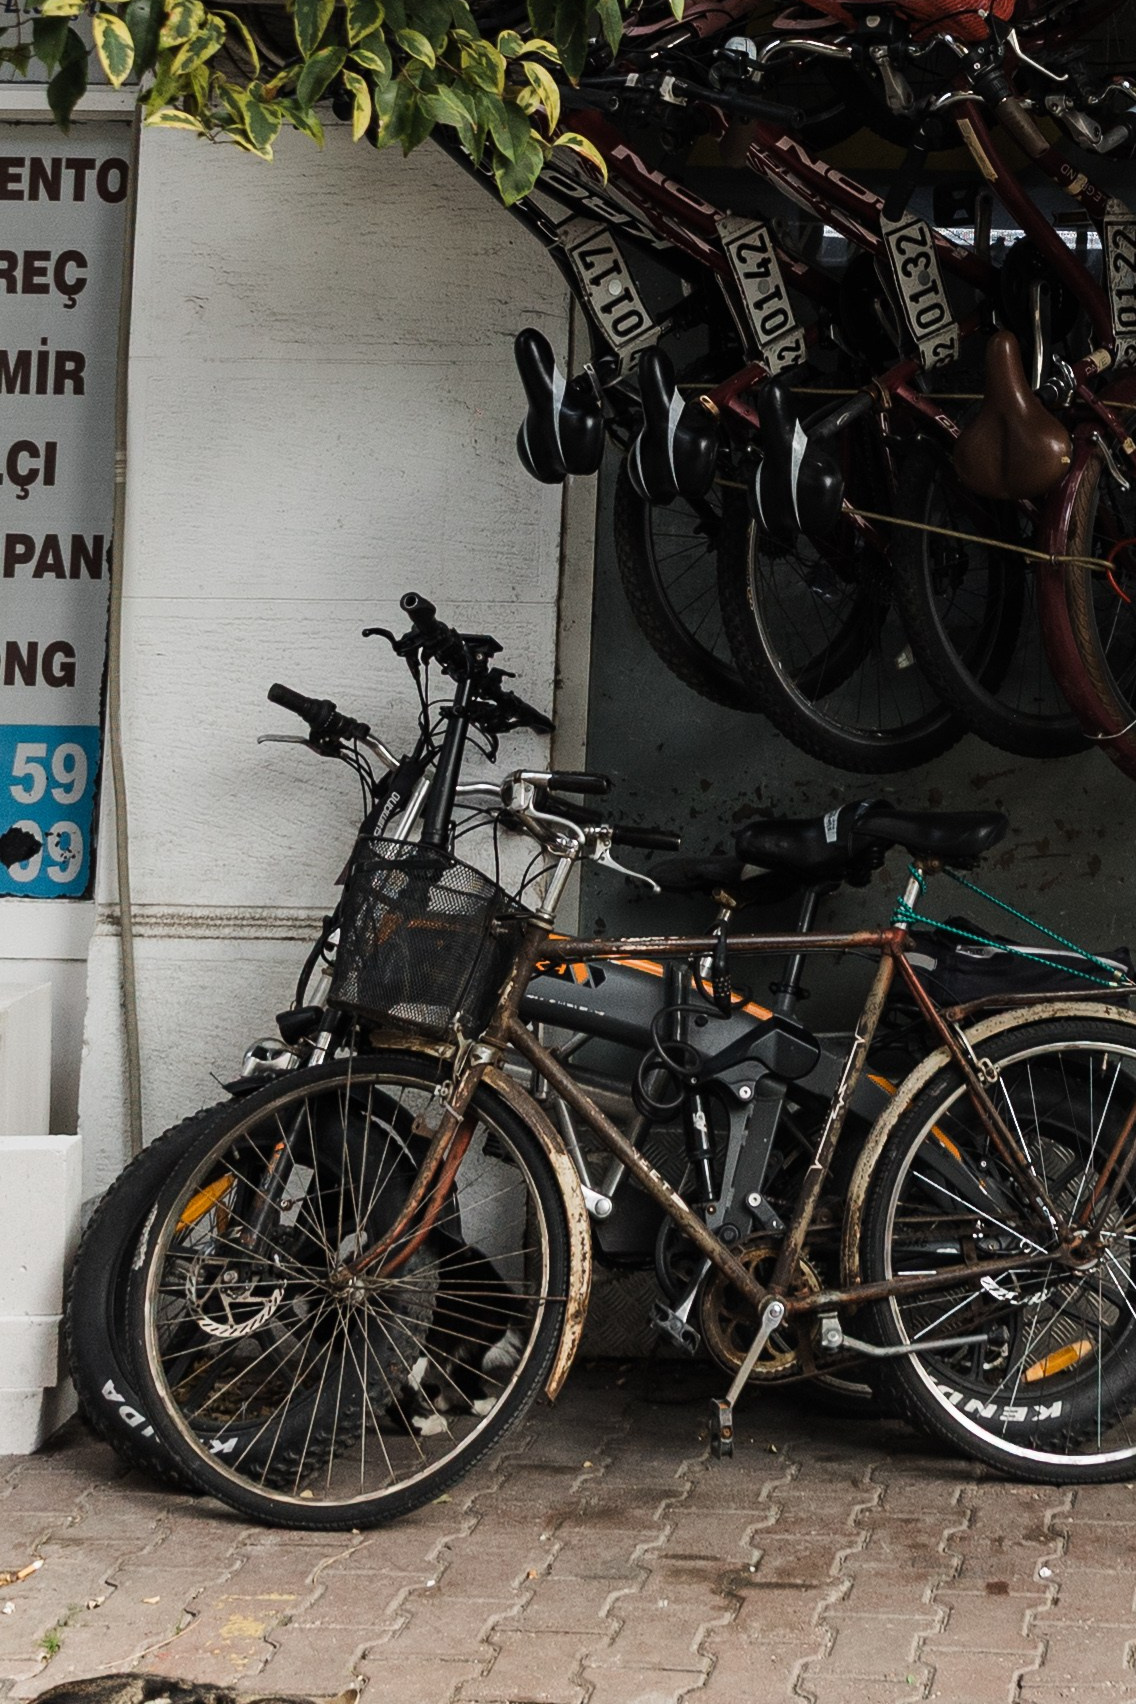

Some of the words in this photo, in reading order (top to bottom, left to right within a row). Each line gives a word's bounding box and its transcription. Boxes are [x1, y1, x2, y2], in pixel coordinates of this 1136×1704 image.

[0, 157, 129, 203] ENTO
[578, 246, 645, 338] 0117
[736, 233, 789, 337] 0142
[896, 227, 945, 336] 0132
[0, 337, 86, 395] MİR
[0, 440, 58, 500] ÇI
[3, 533, 105, 580] PAN
[0, 640, 77, 688] NG
[9, 742, 88, 805] 59
[928, 1375, 1062, 1422] KEND
